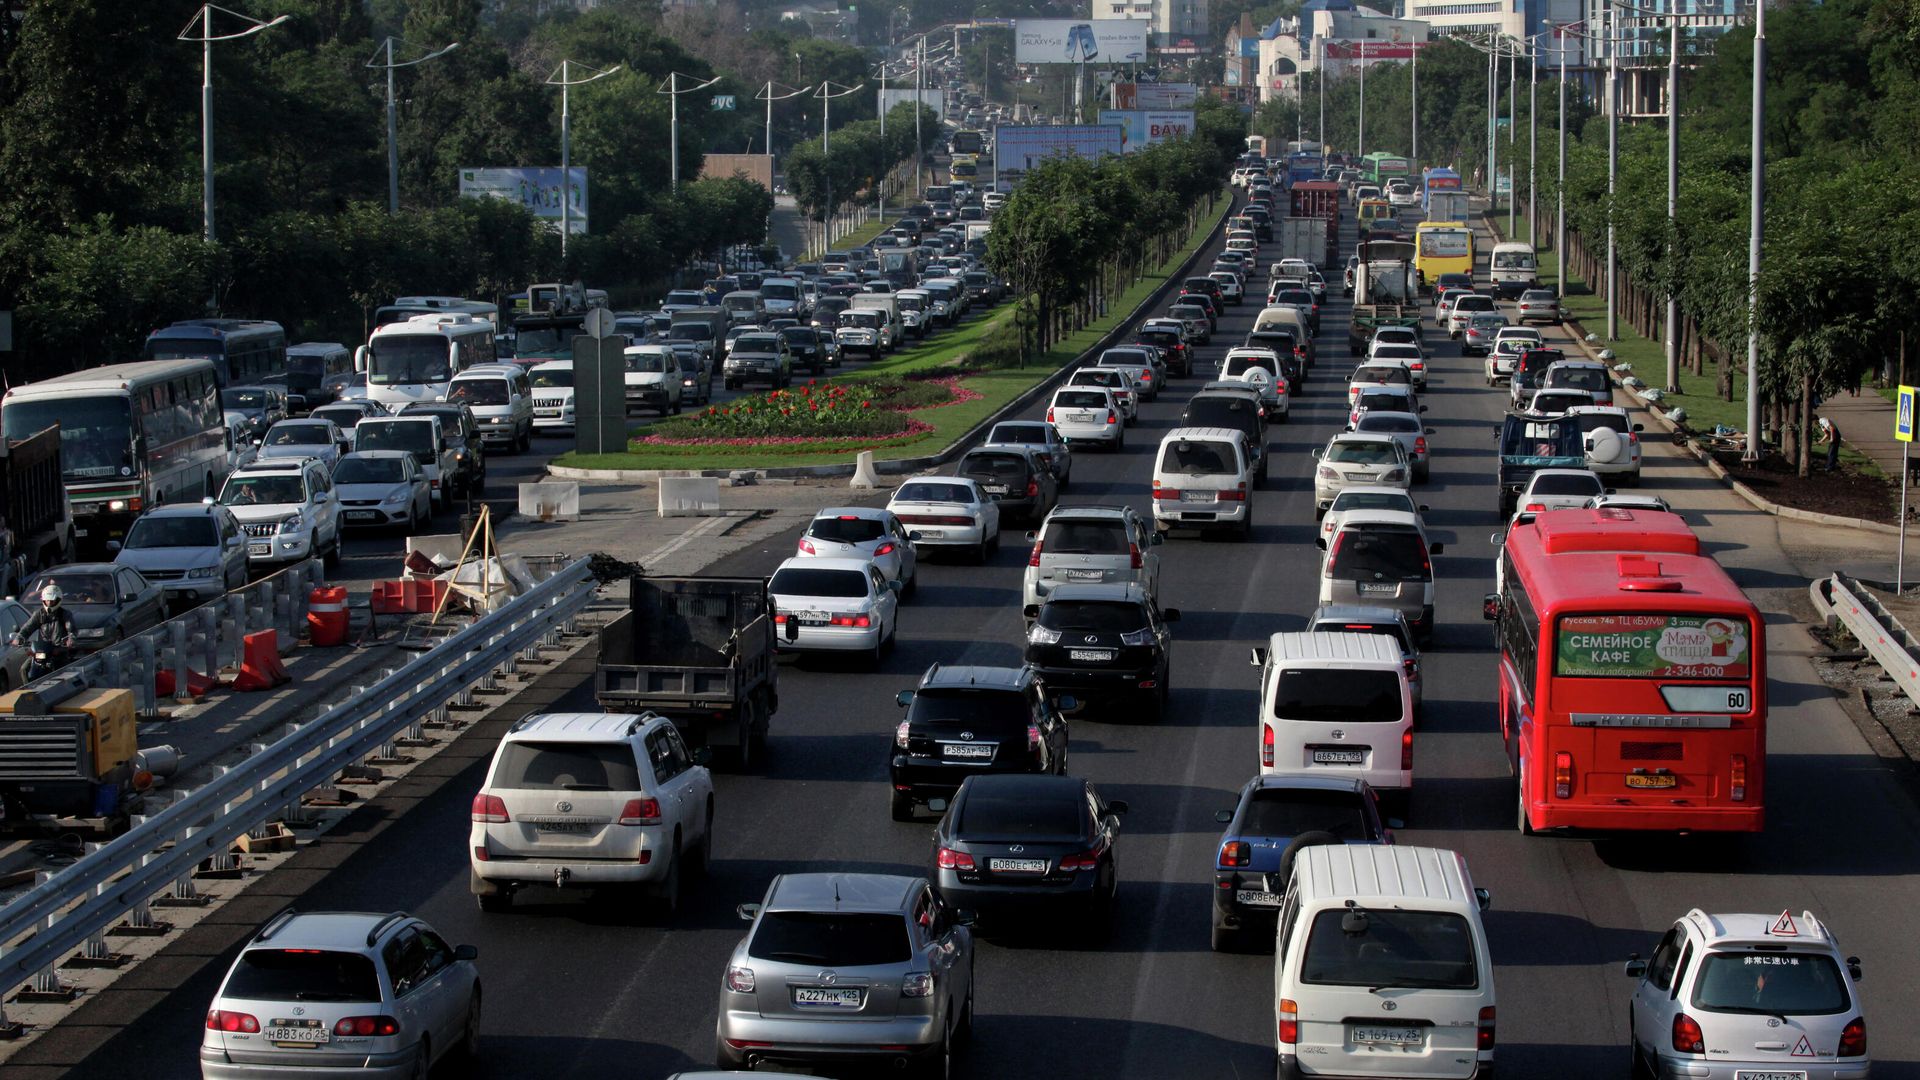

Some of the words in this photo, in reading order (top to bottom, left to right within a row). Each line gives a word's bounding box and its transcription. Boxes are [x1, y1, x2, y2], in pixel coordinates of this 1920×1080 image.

[1021, 38, 1048, 46] GALAXY
[1671, 617, 1678, 626] 3
[1570, 633, 1652, 649] СЕМЕЙНОЕ
[1591, 651, 1631, 663] КАФЕ
[1664, 666, 1724, 677] 2-346-000
[1728, 692, 1745, 708] 60
[1601, 716, 1701, 726] HYUNDAI
[843, 990, 857, 999] 125
[314, 1029, 326, 1038] 25
